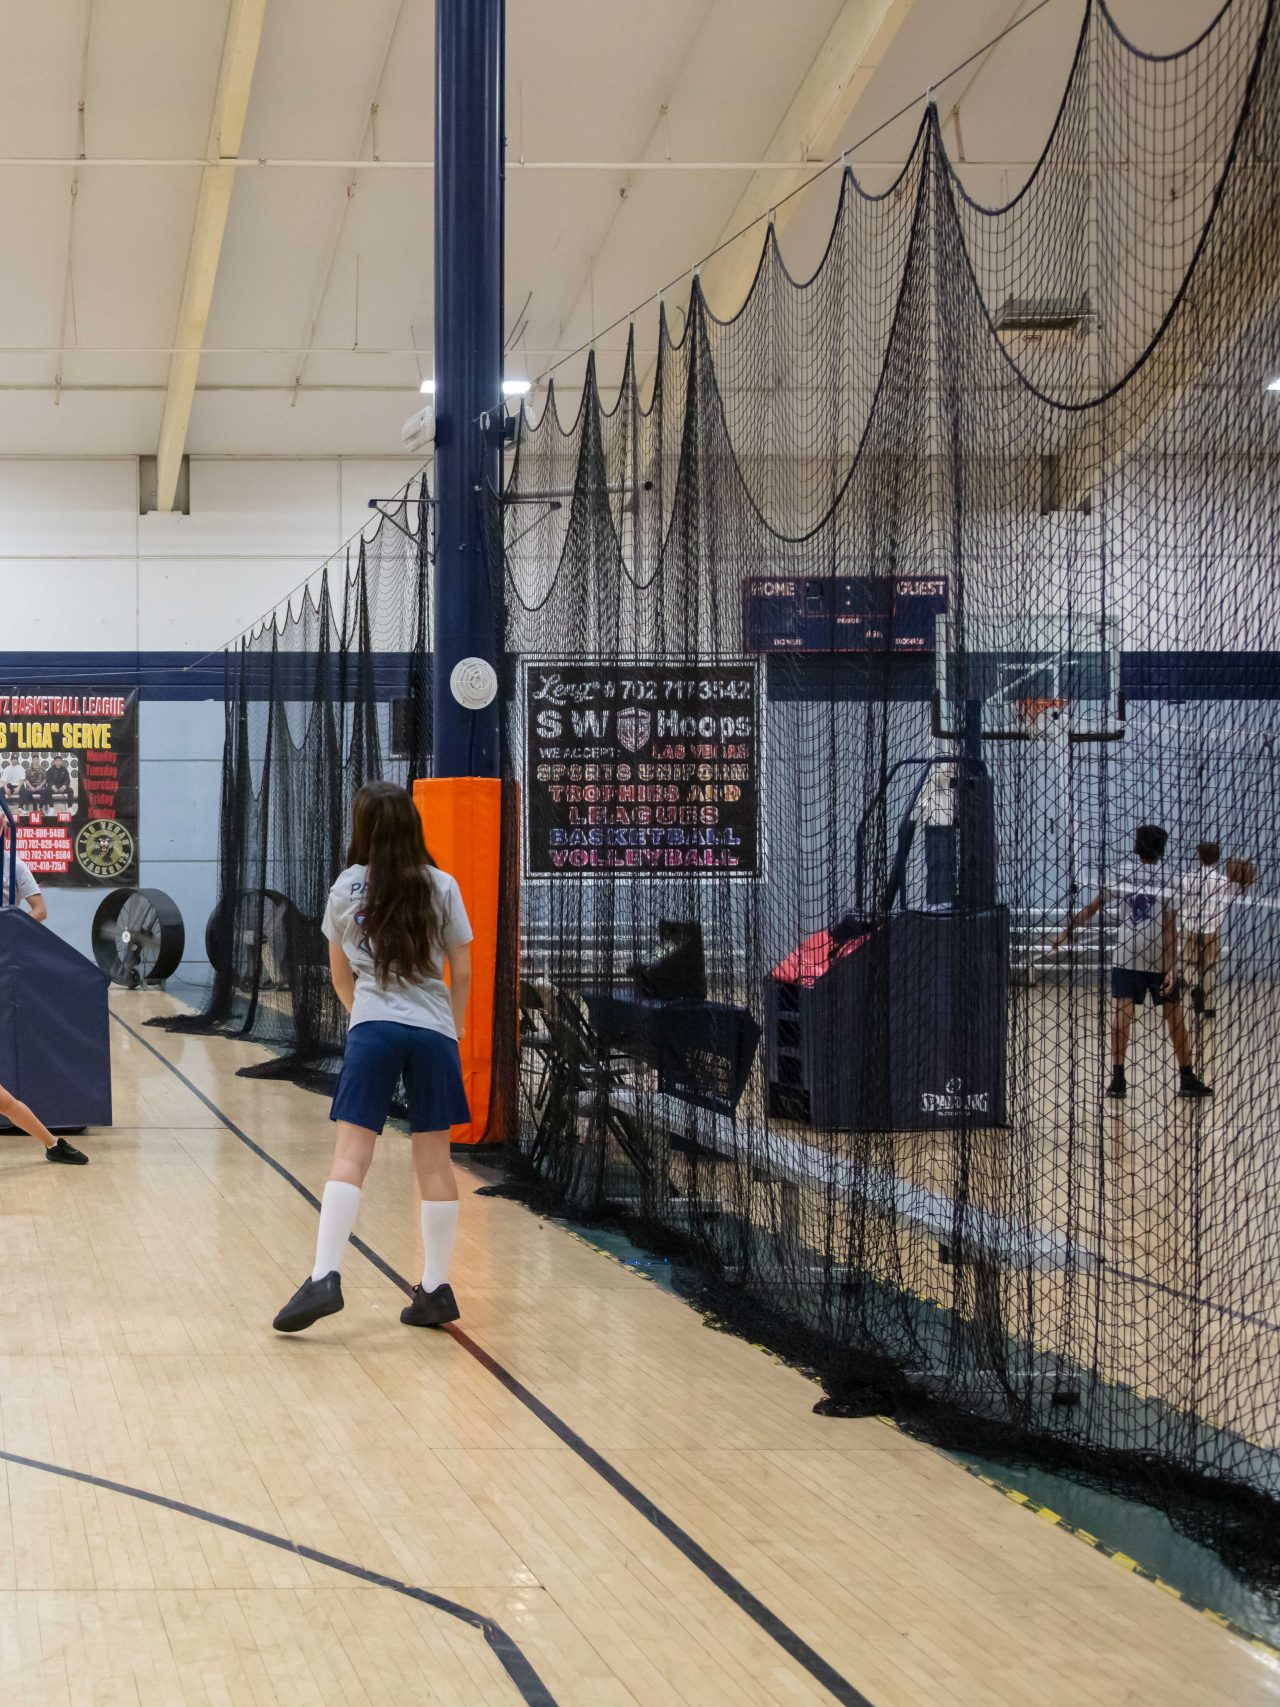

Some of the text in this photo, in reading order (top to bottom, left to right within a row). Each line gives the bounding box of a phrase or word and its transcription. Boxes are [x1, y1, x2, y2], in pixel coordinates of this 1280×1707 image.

[751, 581, 945, 596] HOME GUEST
[12, 696, 81, 717] BASKETBALL
[82, 697, 125, 717] LEAGUE
[9, 722, 60, 749] "LIGA"
[62, 723, 112, 749] SERYE
[657, 709, 752, 743] Hoops
[536, 764, 750, 781] SPORTS UNIFORM
[548, 784, 680, 803] TROPHIES
[569, 806, 720, 825] LEAGUES
[549, 828, 741, 846] BASKETBALL
[549, 849, 739, 866] VOLLEYBALL
